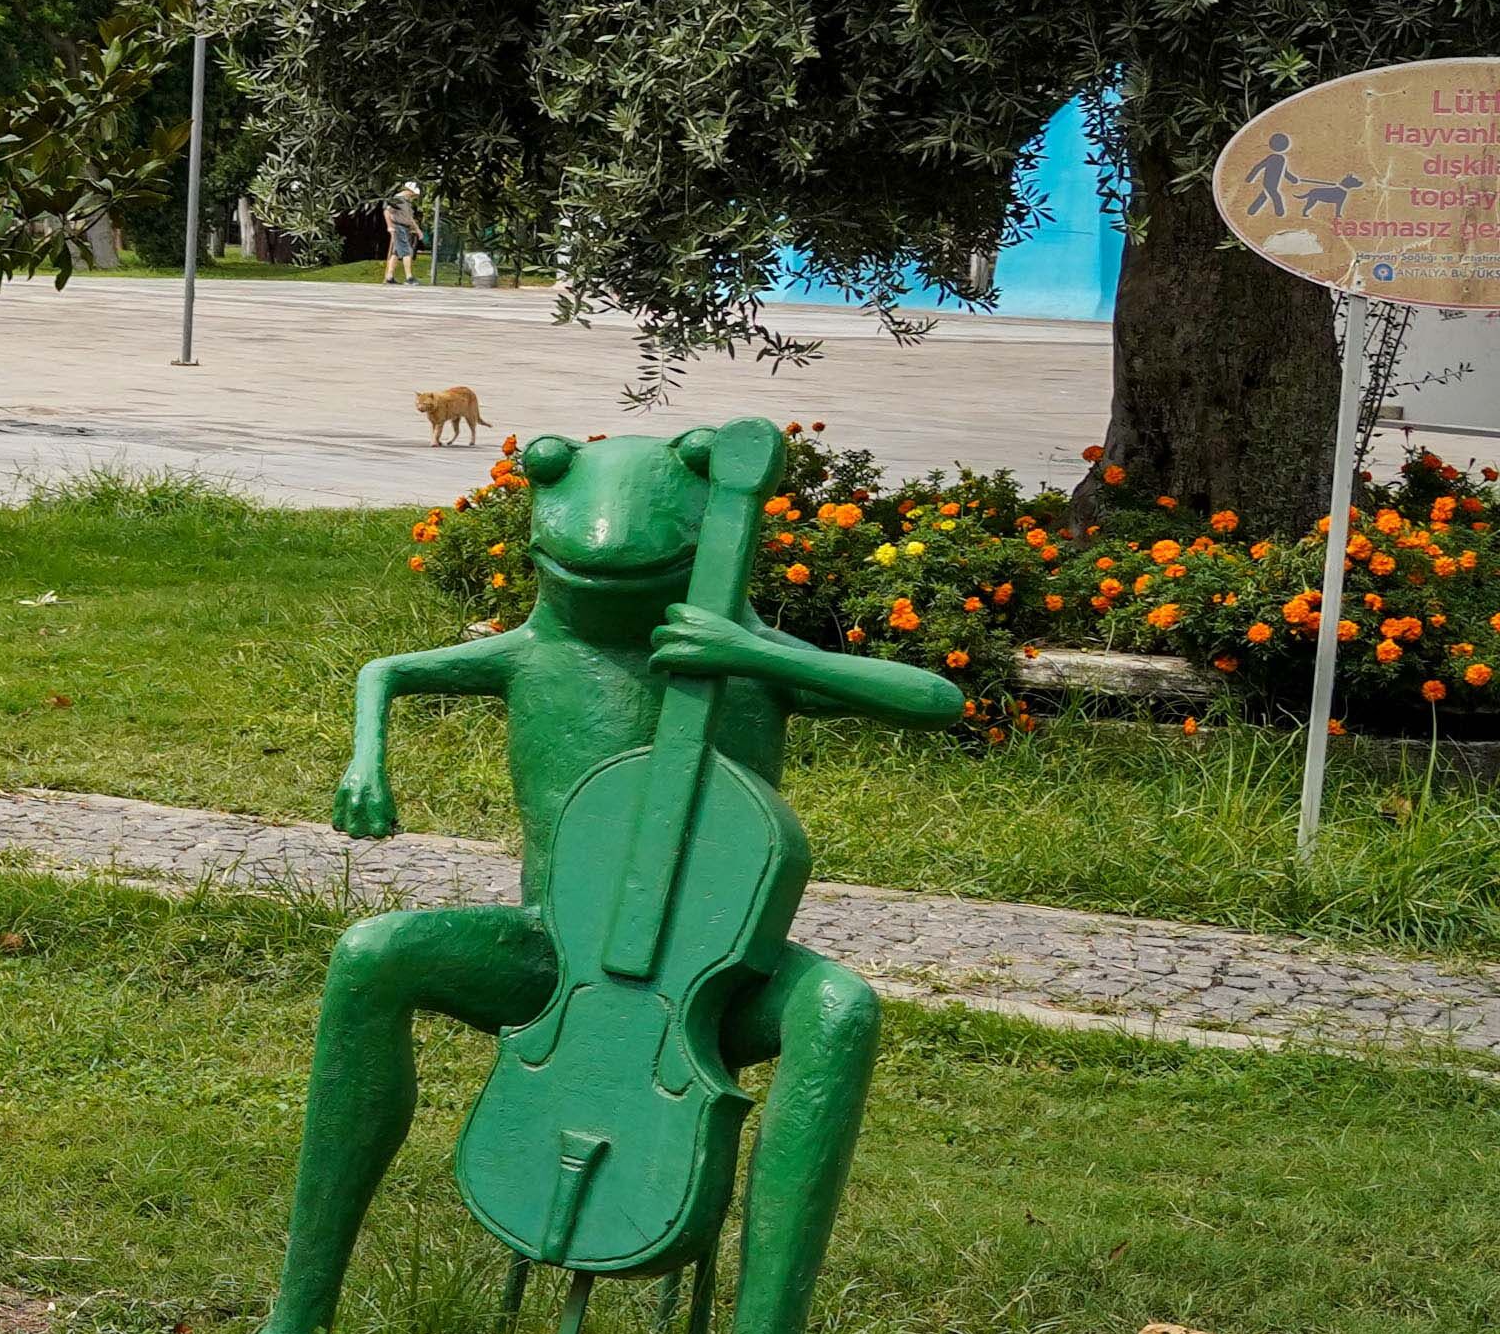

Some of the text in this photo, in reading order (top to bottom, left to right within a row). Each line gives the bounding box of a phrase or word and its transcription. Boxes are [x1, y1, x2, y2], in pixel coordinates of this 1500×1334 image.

[1332, 217, 1450, 237] tasmasız
[1356, 252, 1397, 262] Hayvan
[1397, 267, 1448, 278] ANTALYA
